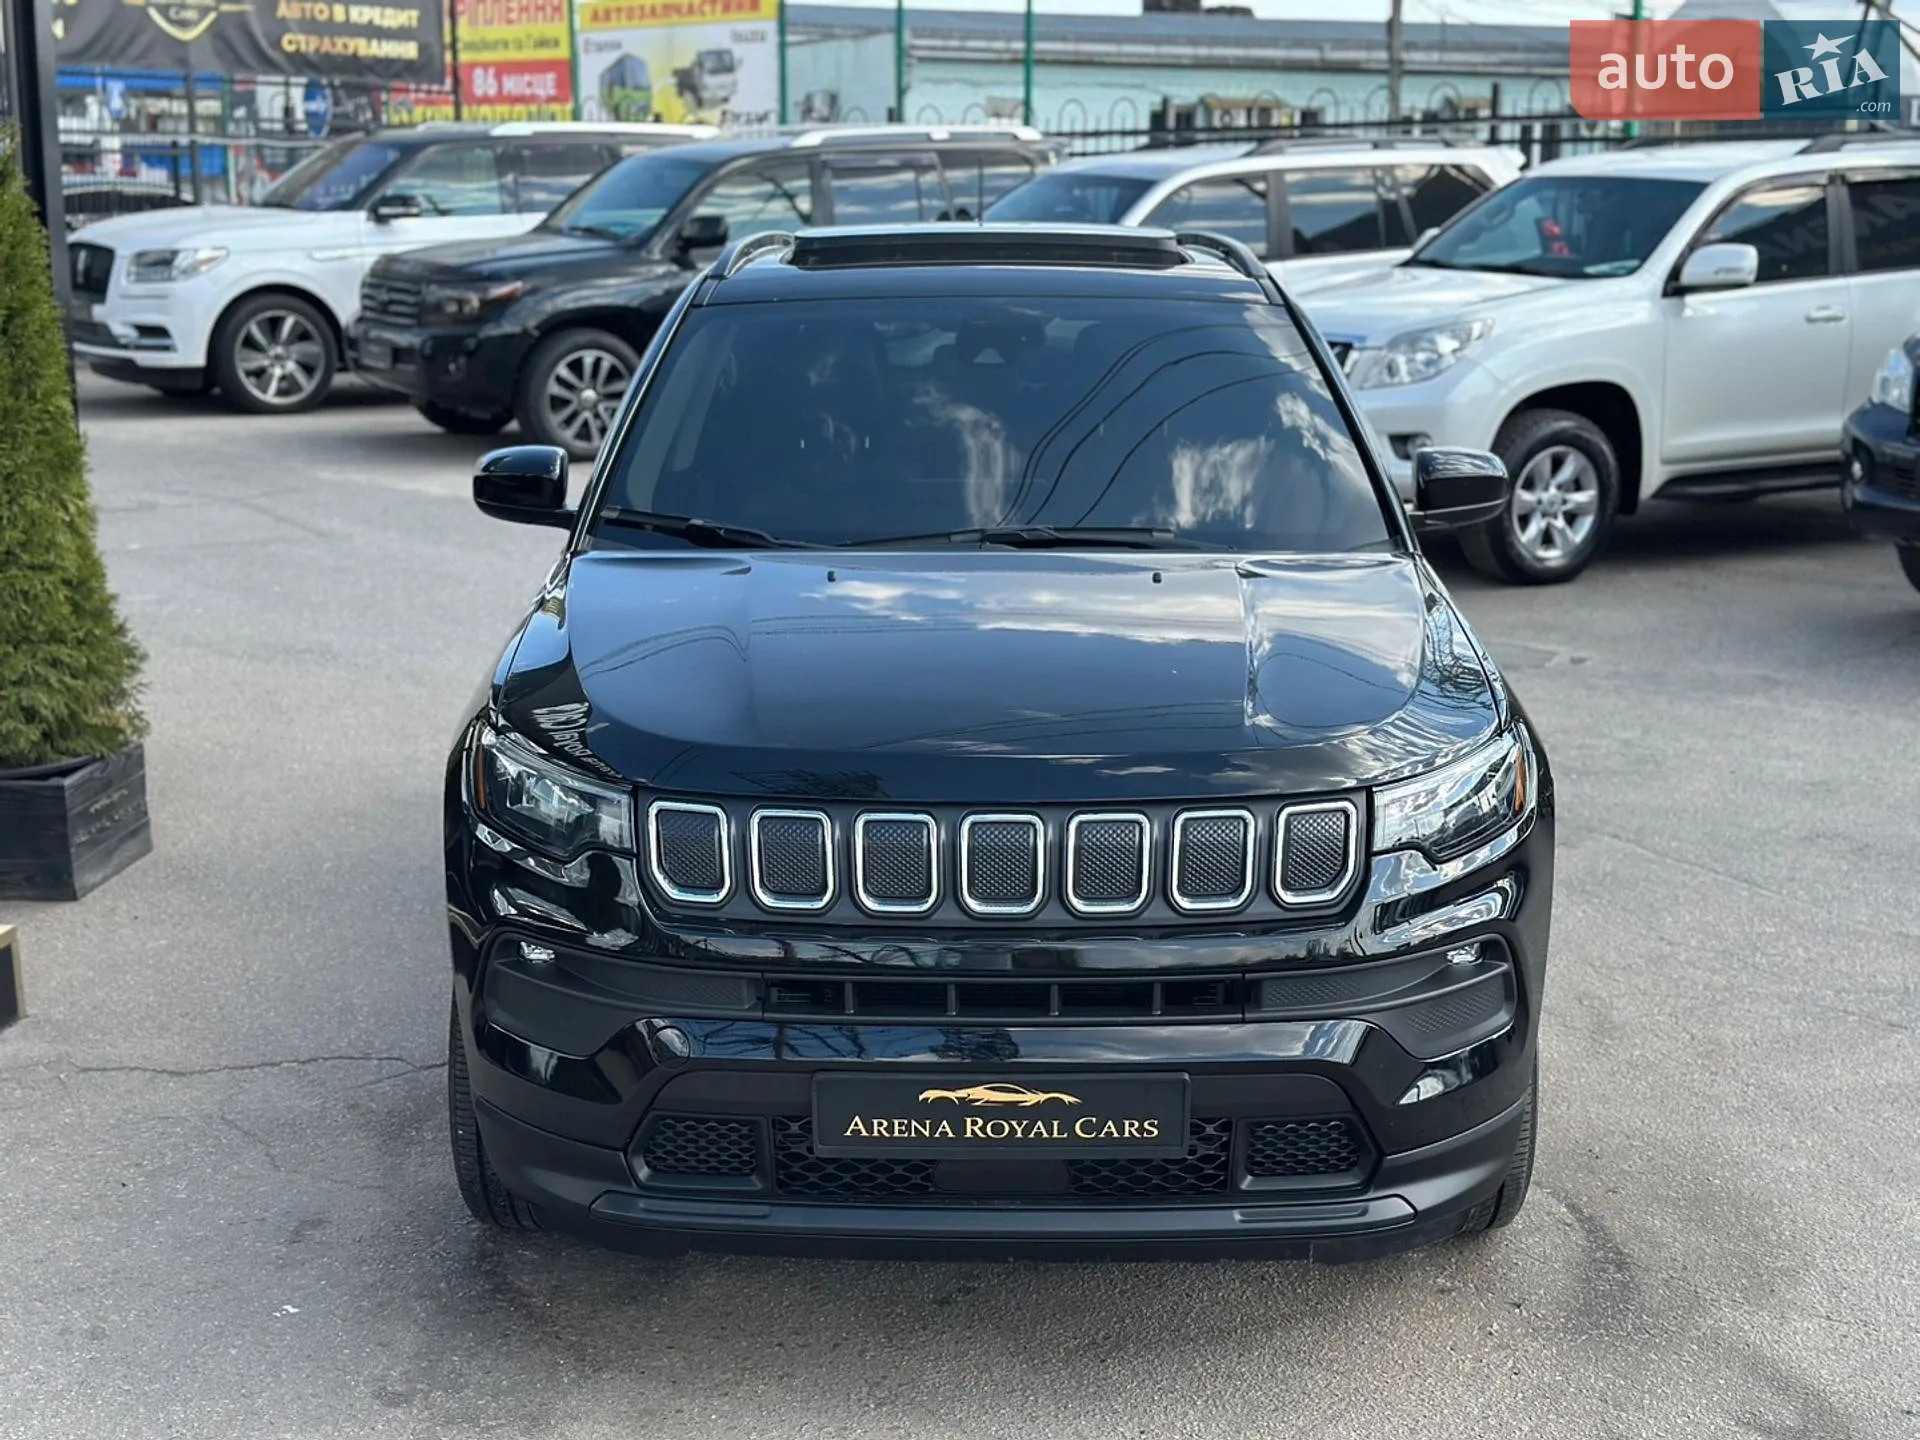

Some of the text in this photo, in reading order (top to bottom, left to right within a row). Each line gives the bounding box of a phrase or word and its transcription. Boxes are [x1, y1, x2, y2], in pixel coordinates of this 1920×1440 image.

[277, 1, 420, 29] АВТО В КРЕДИТ
[280, 32, 420, 61] СТРАХУВАННЯ
[472, 66, 498, 97] 86
[843, 1115, 1160, 1139] ARENA ROYAL CARS
